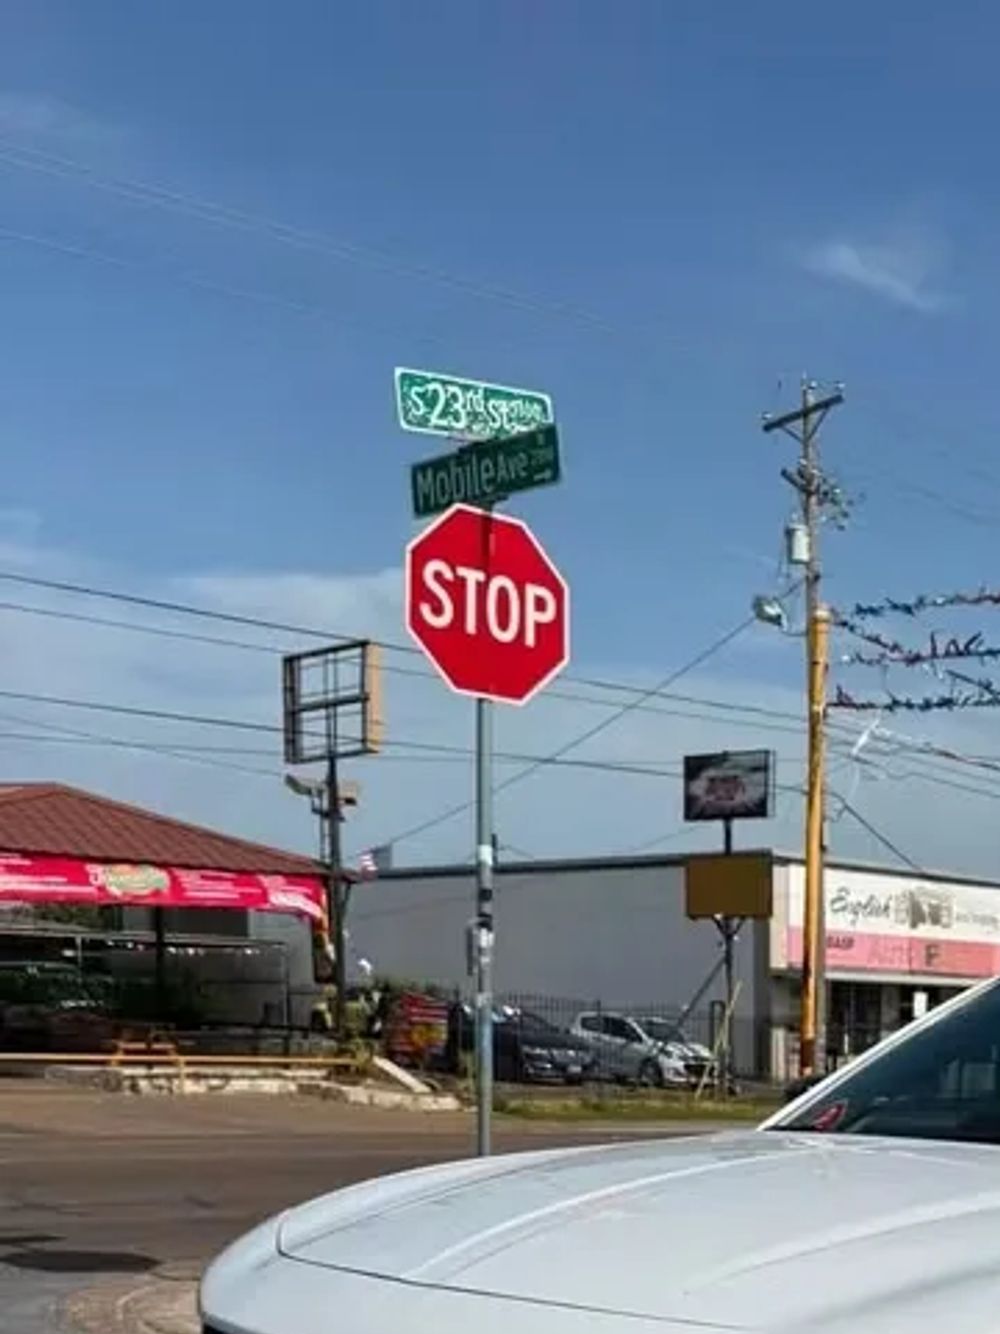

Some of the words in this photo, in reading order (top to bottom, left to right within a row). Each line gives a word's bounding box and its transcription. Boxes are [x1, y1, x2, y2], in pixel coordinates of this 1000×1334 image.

[410, 386, 426, 416] S
[425, 383, 485, 429] 23rd
[487, 399, 511, 430] St
[417, 450, 495, 509] Mobile
[497, 452, 529, 484] Ave
[419, 559, 557, 648] STOP
